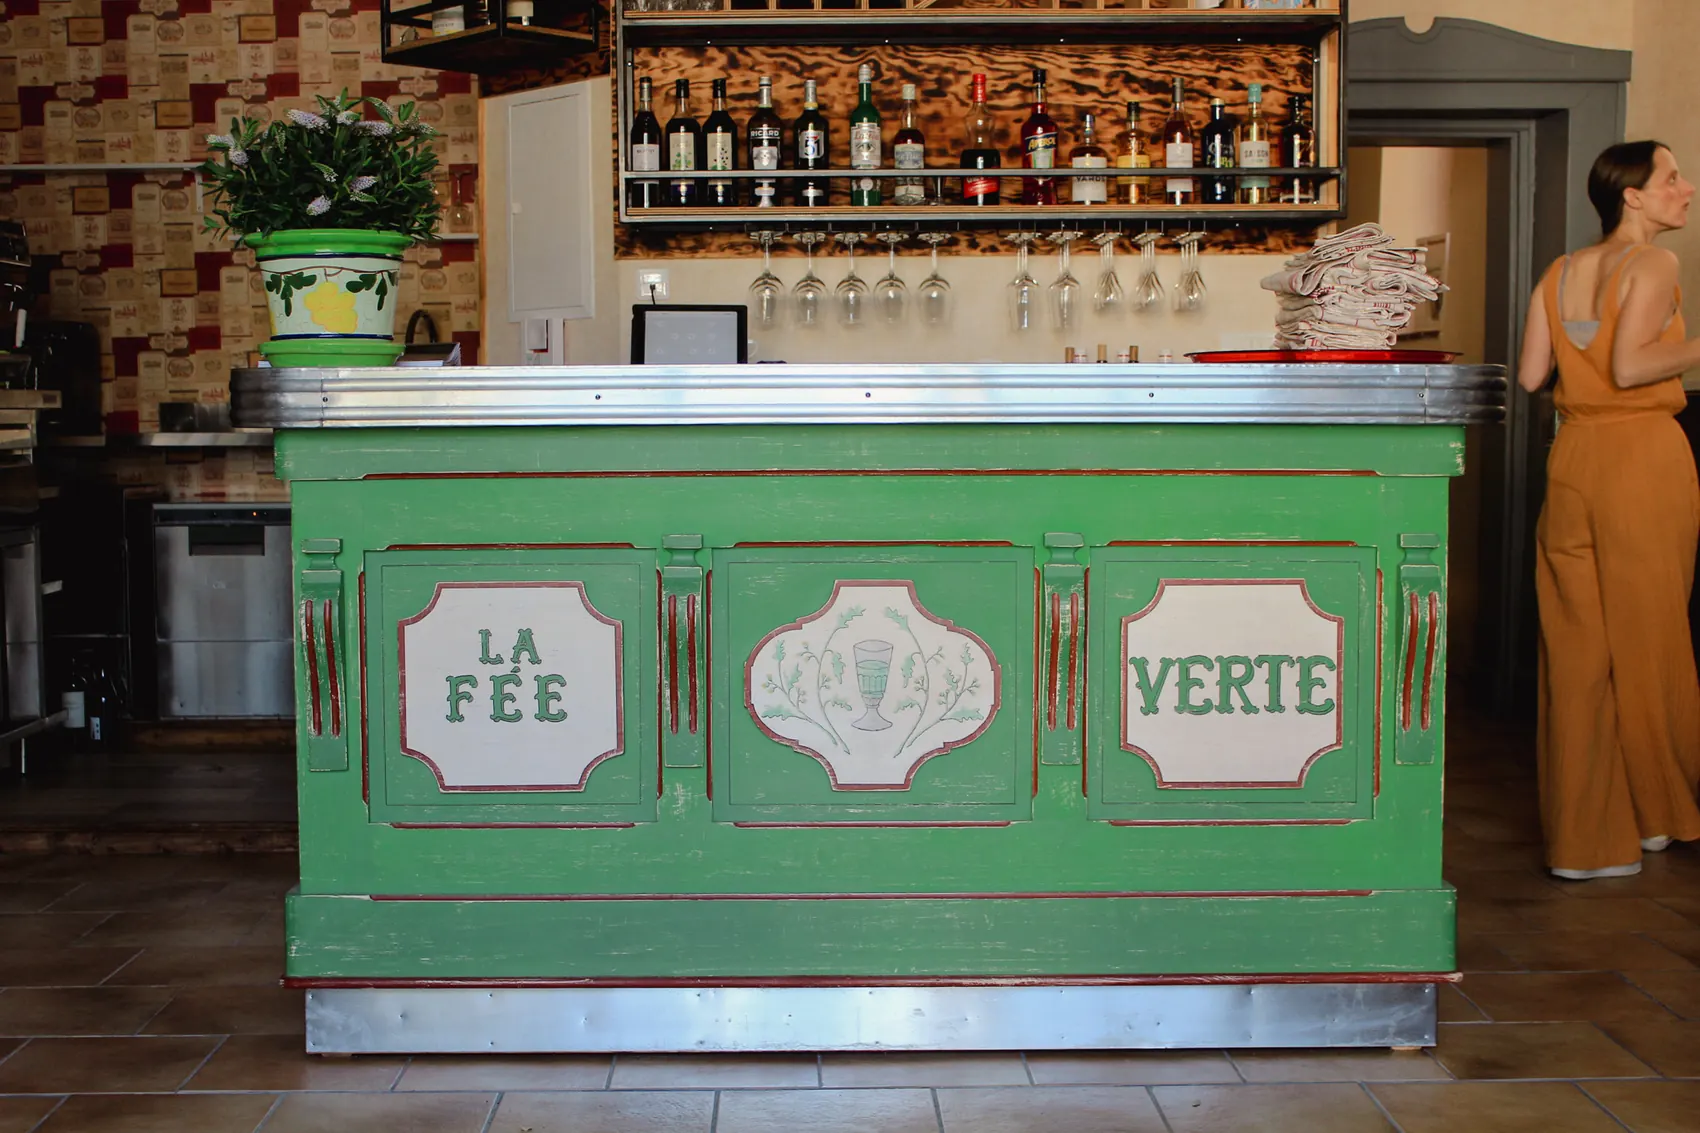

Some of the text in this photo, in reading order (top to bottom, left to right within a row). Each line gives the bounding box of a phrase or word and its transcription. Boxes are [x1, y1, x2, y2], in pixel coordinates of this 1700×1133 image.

[478, 628, 542, 665] LA
[445, 666, 568, 723] FÉE
[1129, 654, 1337, 716] VERTE
